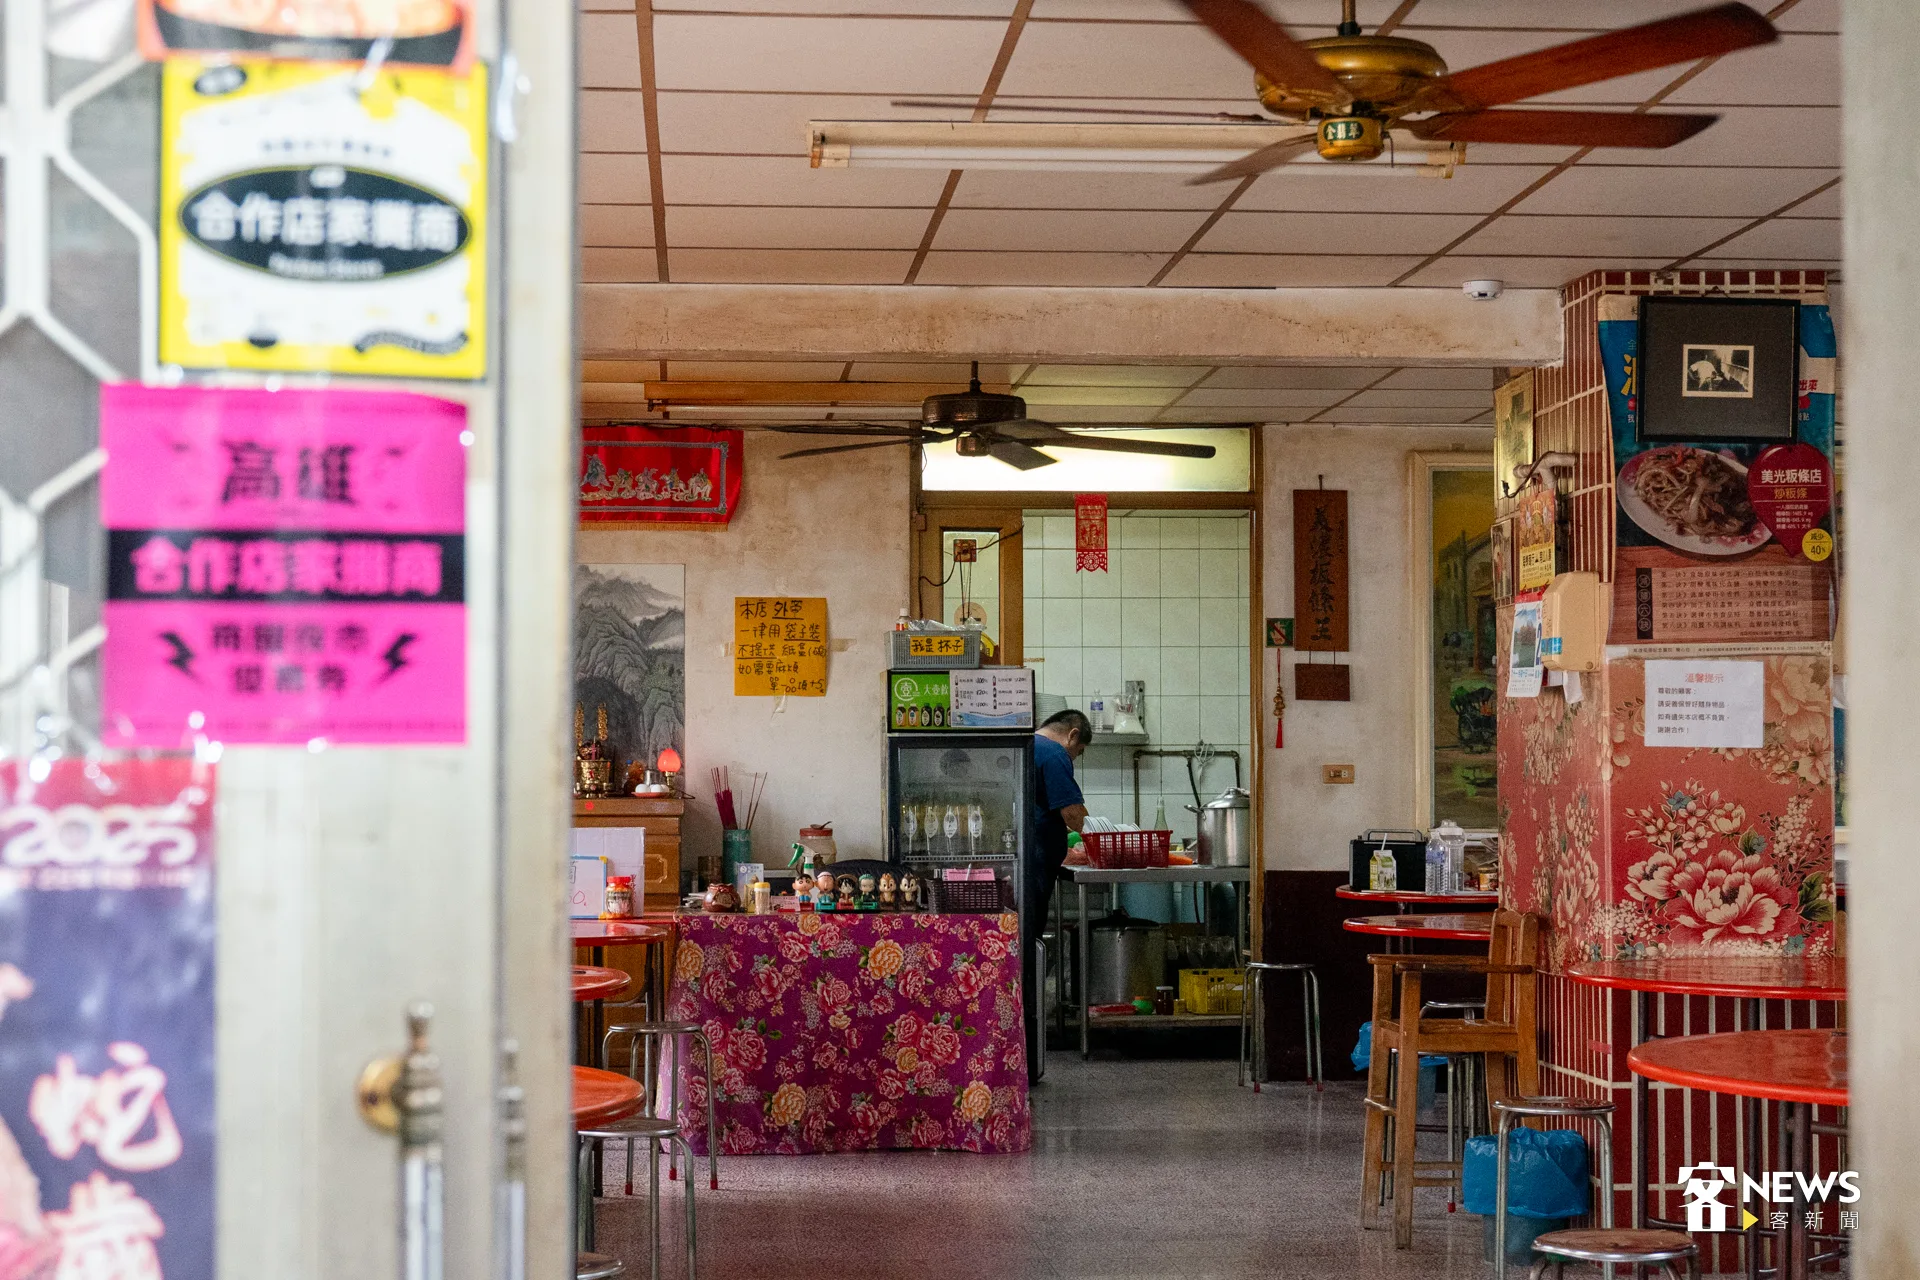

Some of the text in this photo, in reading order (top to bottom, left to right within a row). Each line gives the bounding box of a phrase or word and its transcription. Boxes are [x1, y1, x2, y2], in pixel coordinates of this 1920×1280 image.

[222, 441, 356, 506] 高雄
[1761, 469, 1822, 484] 美光粄條店
[1774, 488, 1808, 499] 炒粄條
[739, 600, 803, 620] 本店 外帶
[739, 622, 821, 640] 一律用 袋子裝
[738, 643, 777, 657] 不提供
[911, 637, 963, 653] 我是 杯子
[738, 660, 799, 675] 如需要麻煩
[1684, 672, 1725, 684] 溫馨提示
[0, 804, 197, 866] 2025
